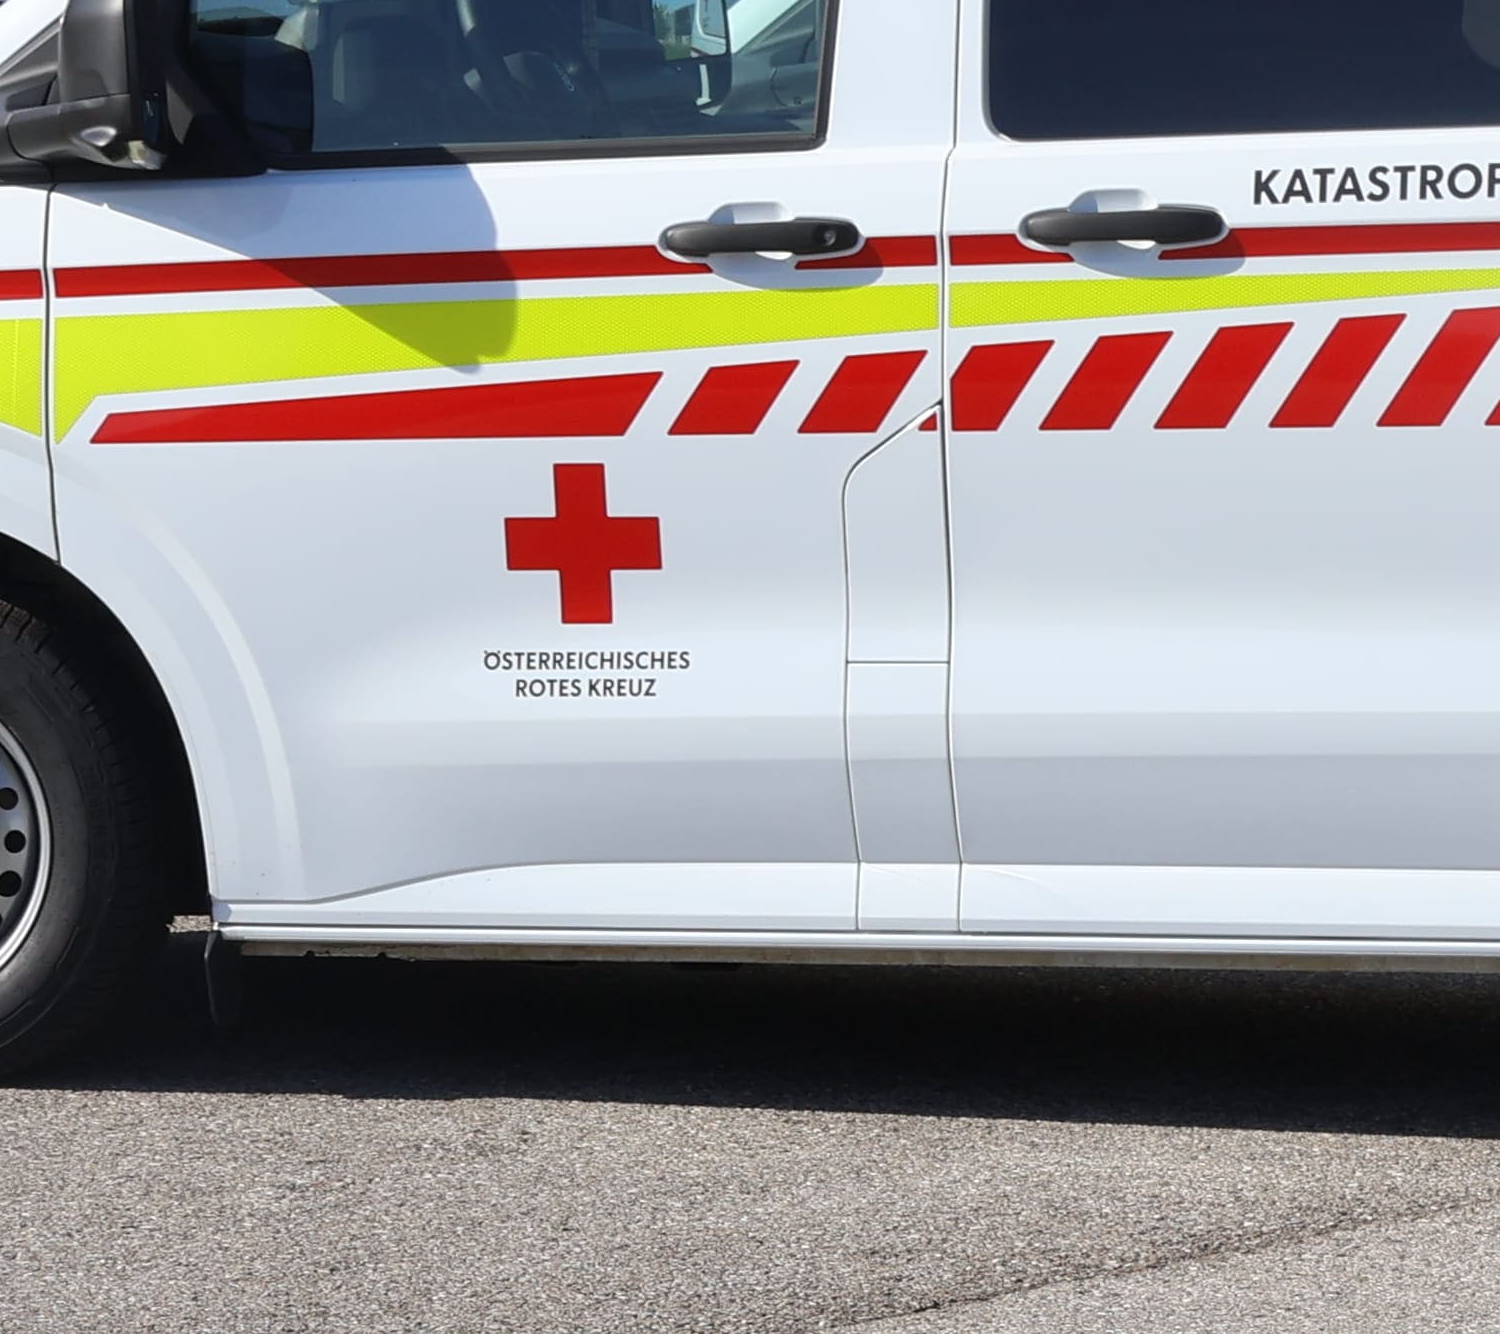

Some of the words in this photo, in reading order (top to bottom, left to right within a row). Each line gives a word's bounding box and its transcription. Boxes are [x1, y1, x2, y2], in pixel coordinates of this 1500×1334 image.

[483, 650, 690, 671] ÖSTERREICHISCHES
[515, 678, 582, 697] ROTES
[588, 678, 656, 697] KREUZ
